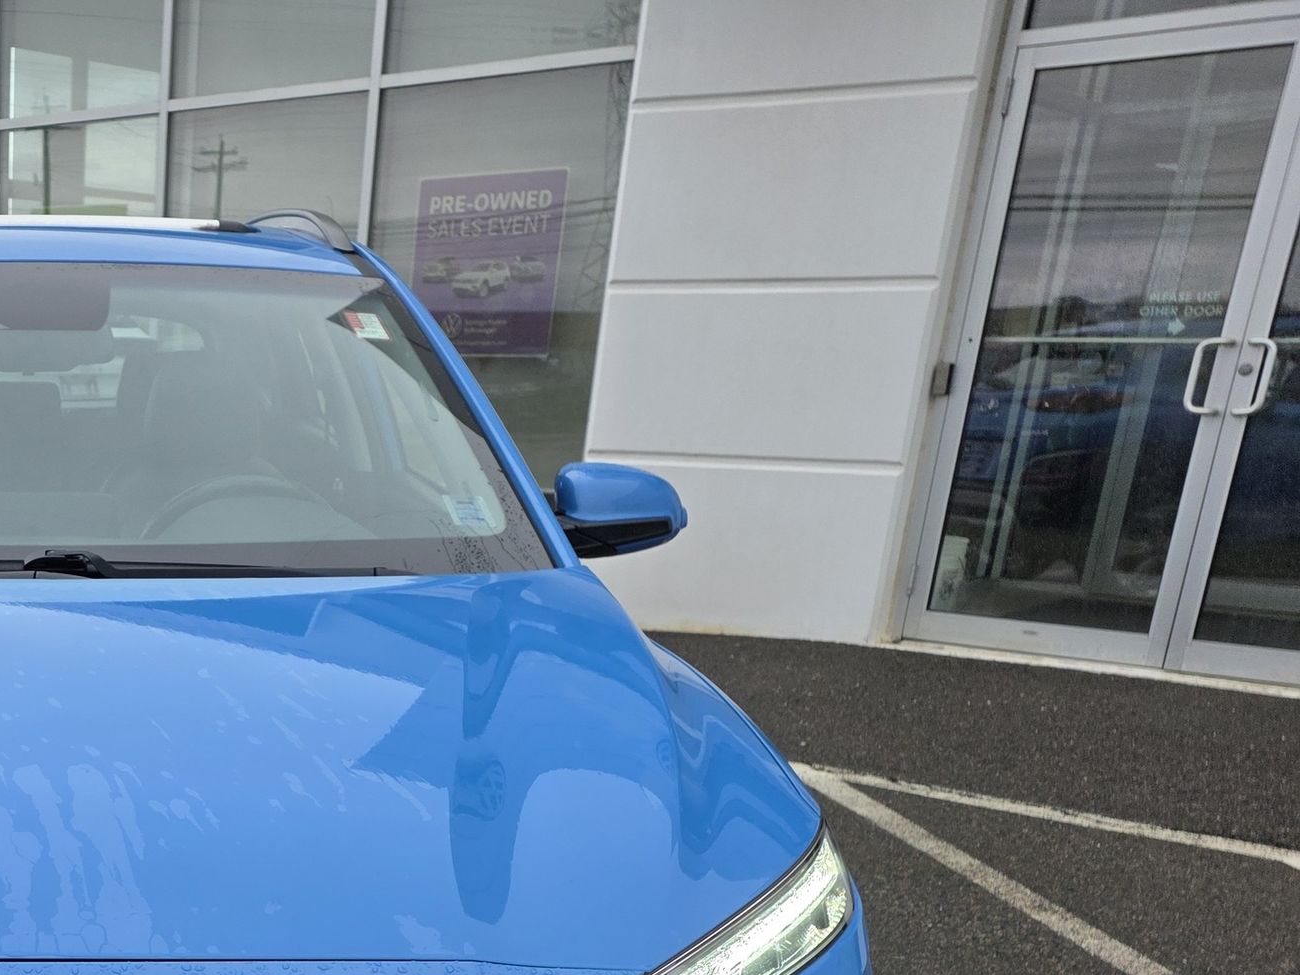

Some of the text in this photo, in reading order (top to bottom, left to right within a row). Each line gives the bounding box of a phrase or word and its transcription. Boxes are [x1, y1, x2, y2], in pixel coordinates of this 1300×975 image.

[429, 189, 553, 215] PRE-OWNED
[427, 213, 550, 239] SALES EVENT
[1139, 304, 1224, 318] OTHER DOOR
